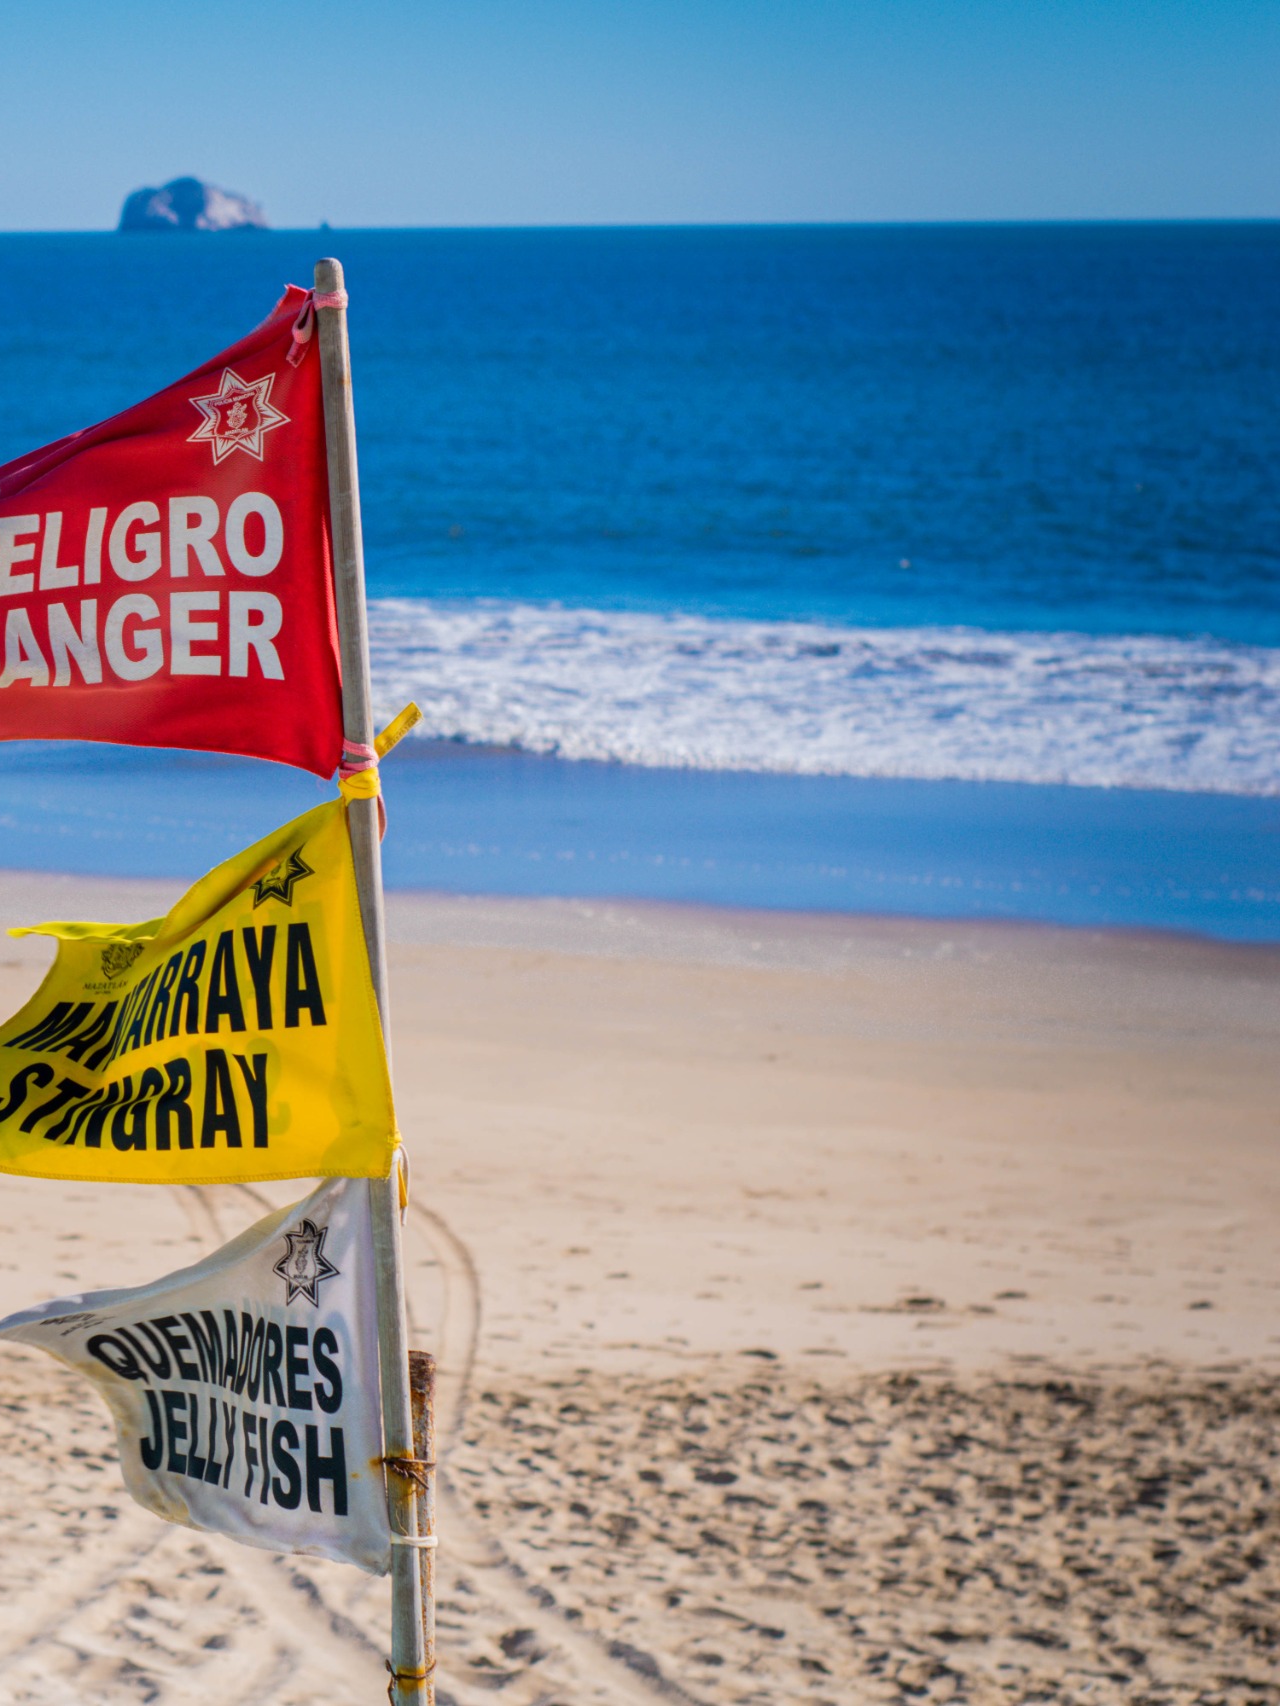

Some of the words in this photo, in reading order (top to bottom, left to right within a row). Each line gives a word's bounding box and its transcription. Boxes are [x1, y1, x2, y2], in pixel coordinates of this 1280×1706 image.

[3, 922, 327, 1072] MANTARRAYA
[86, 1309, 343, 1414] QUEMADORES
[139, 1389, 237, 1490] JELLY
[242, 1411, 348, 1517] FISH
